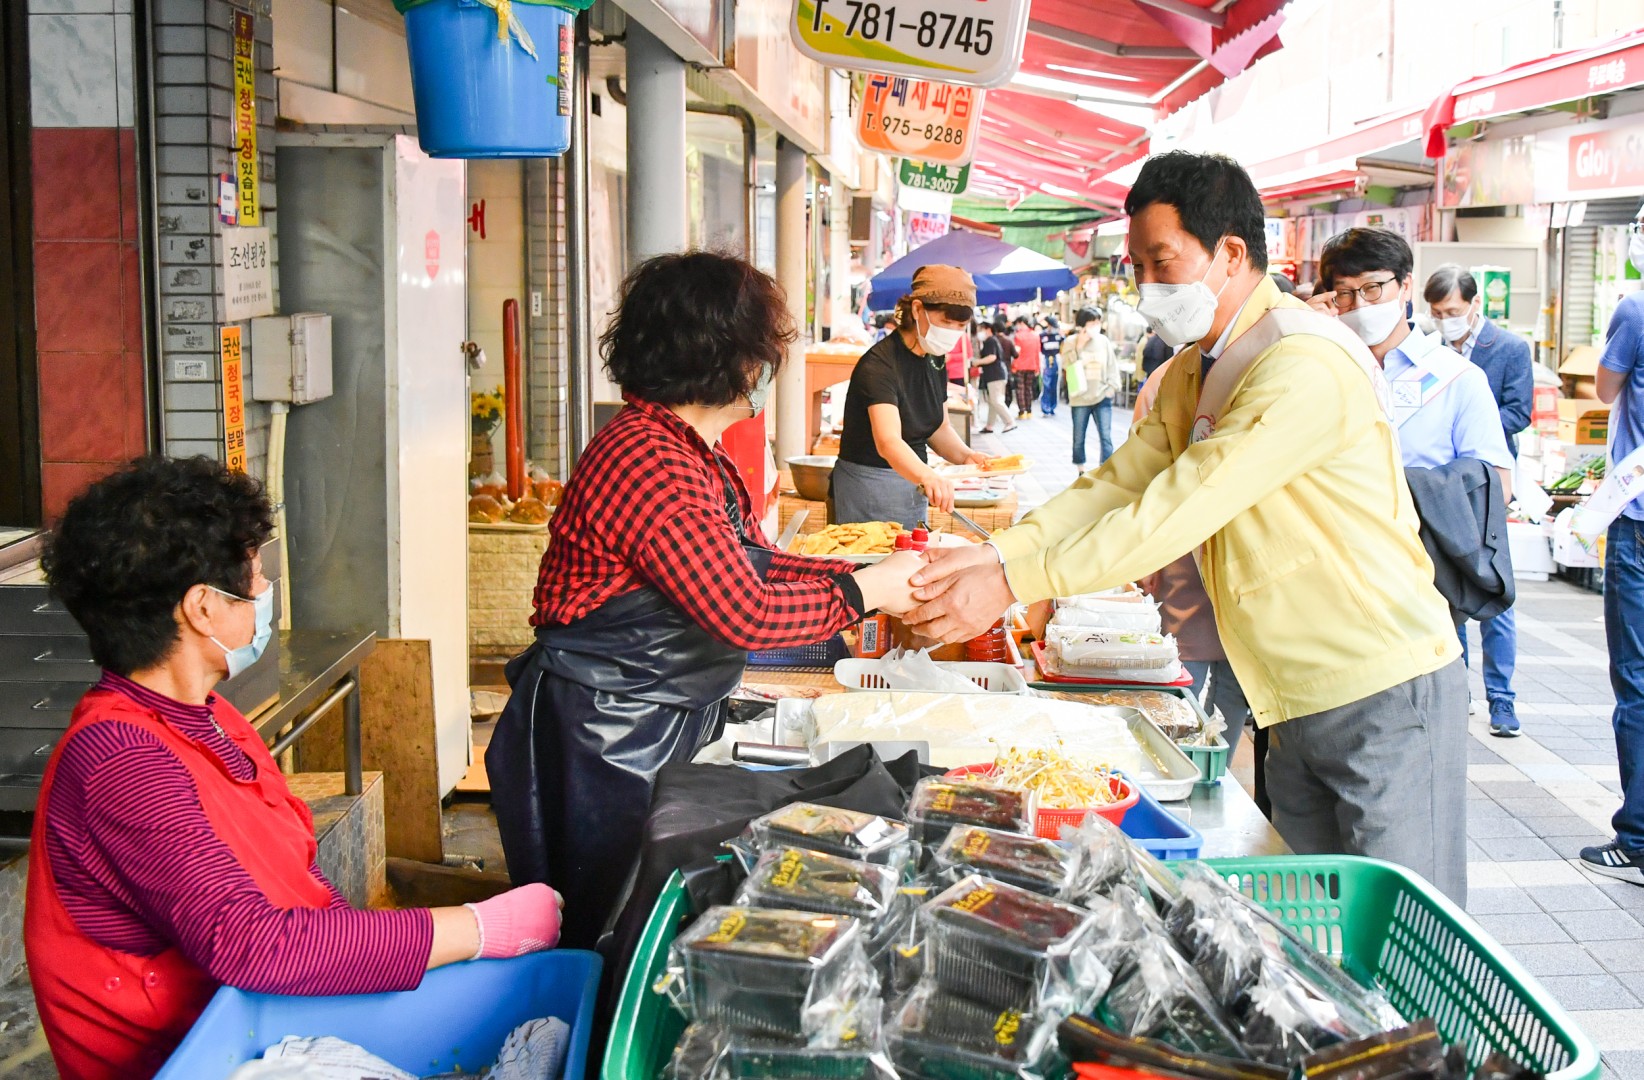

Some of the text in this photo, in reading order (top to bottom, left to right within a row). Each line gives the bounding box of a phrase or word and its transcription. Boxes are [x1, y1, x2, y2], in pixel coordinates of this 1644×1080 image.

[812, 0, 994, 56] T. 781-8745
[236, 61, 255, 218] 국산 청국장 있습니다
[882, 116, 963, 145] 975-8288
[1576, 139, 1620, 185] Glory
[907, 172, 958, 194] 781-3007
[230, 242, 266, 269] 조선된장
[223, 336, 240, 357] 국산
[227, 364, 241, 423] 청국장
[228, 428, 244, 450] 분말
